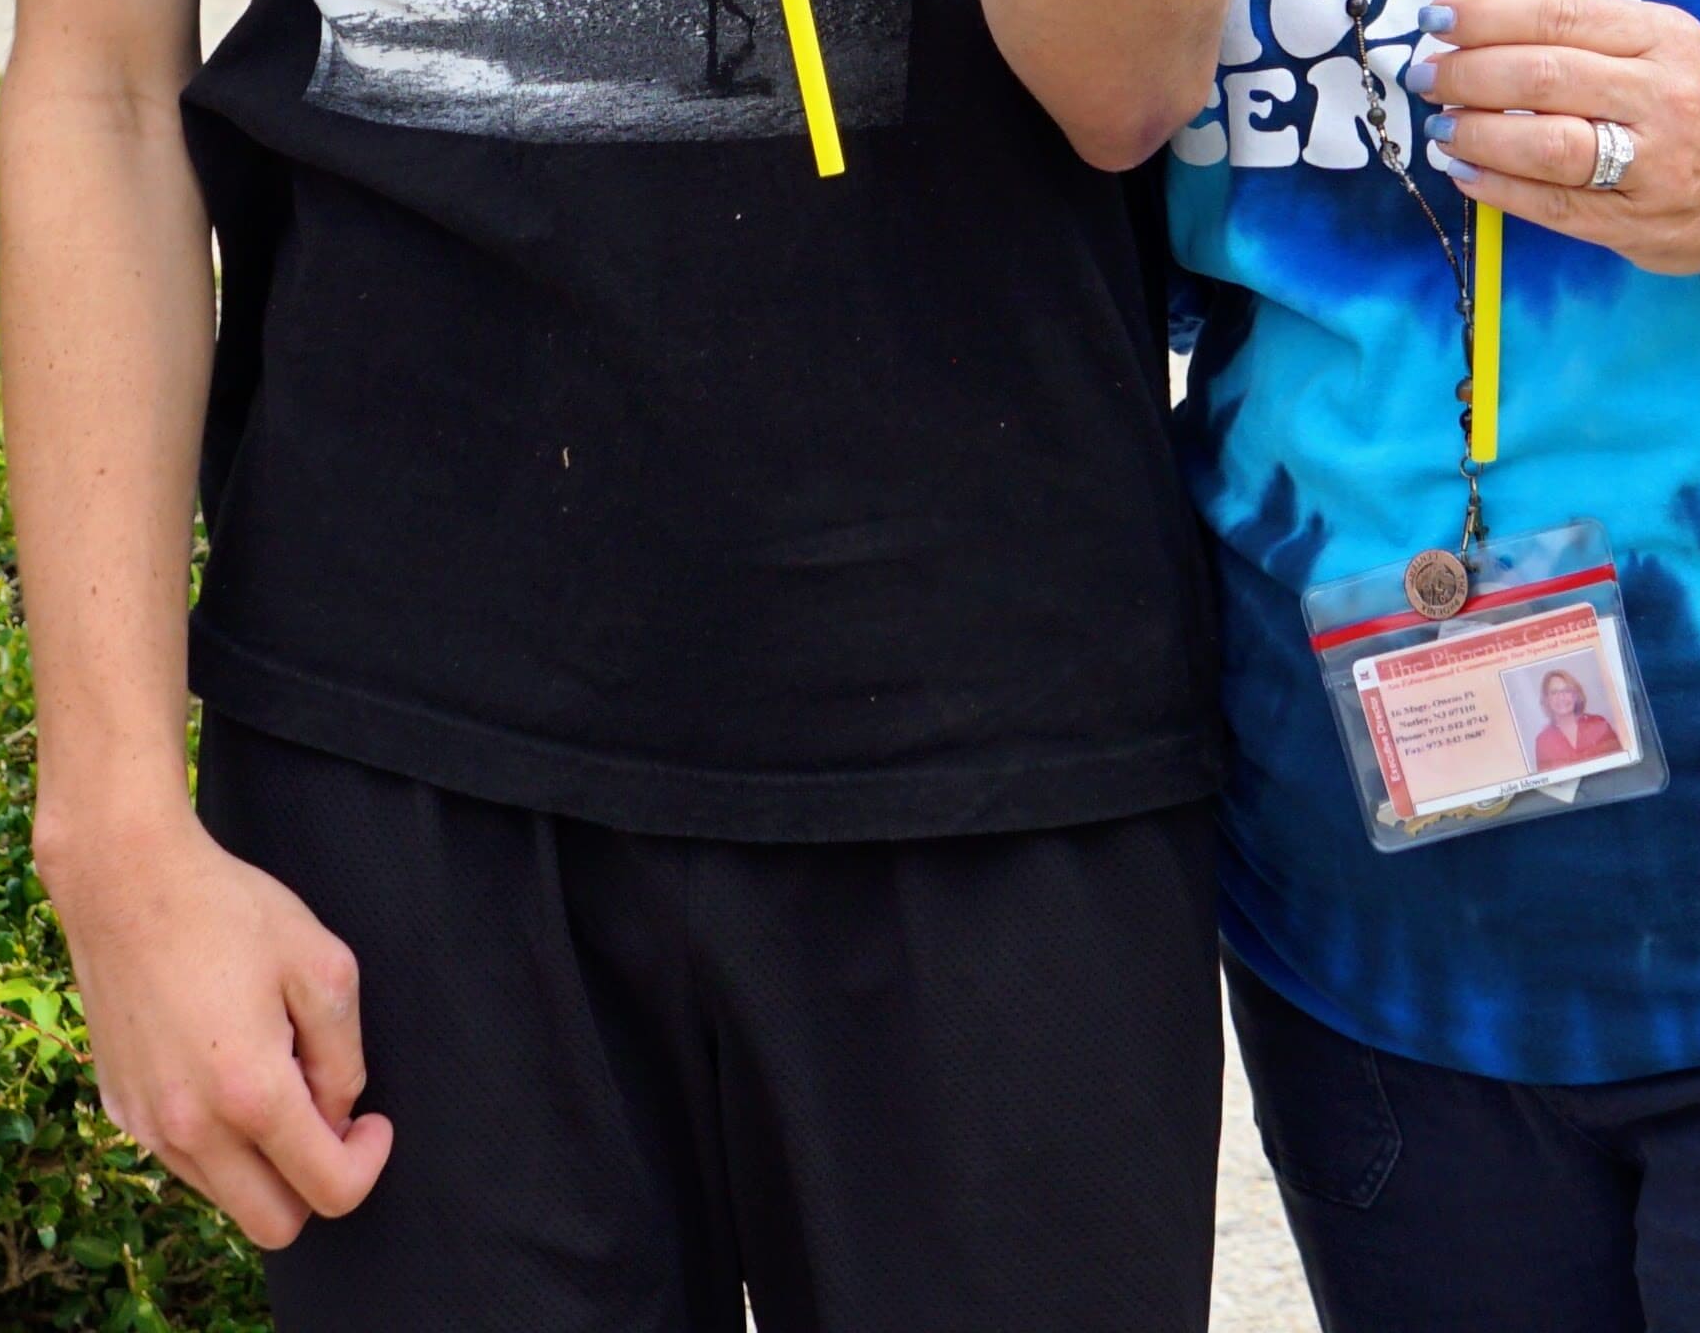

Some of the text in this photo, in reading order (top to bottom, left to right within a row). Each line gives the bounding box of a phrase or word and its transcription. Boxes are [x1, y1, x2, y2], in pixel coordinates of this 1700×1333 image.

[1381, 617, 1597, 680] The Phoenix Center
[1369, 695, 1400, 782] Executive Director
